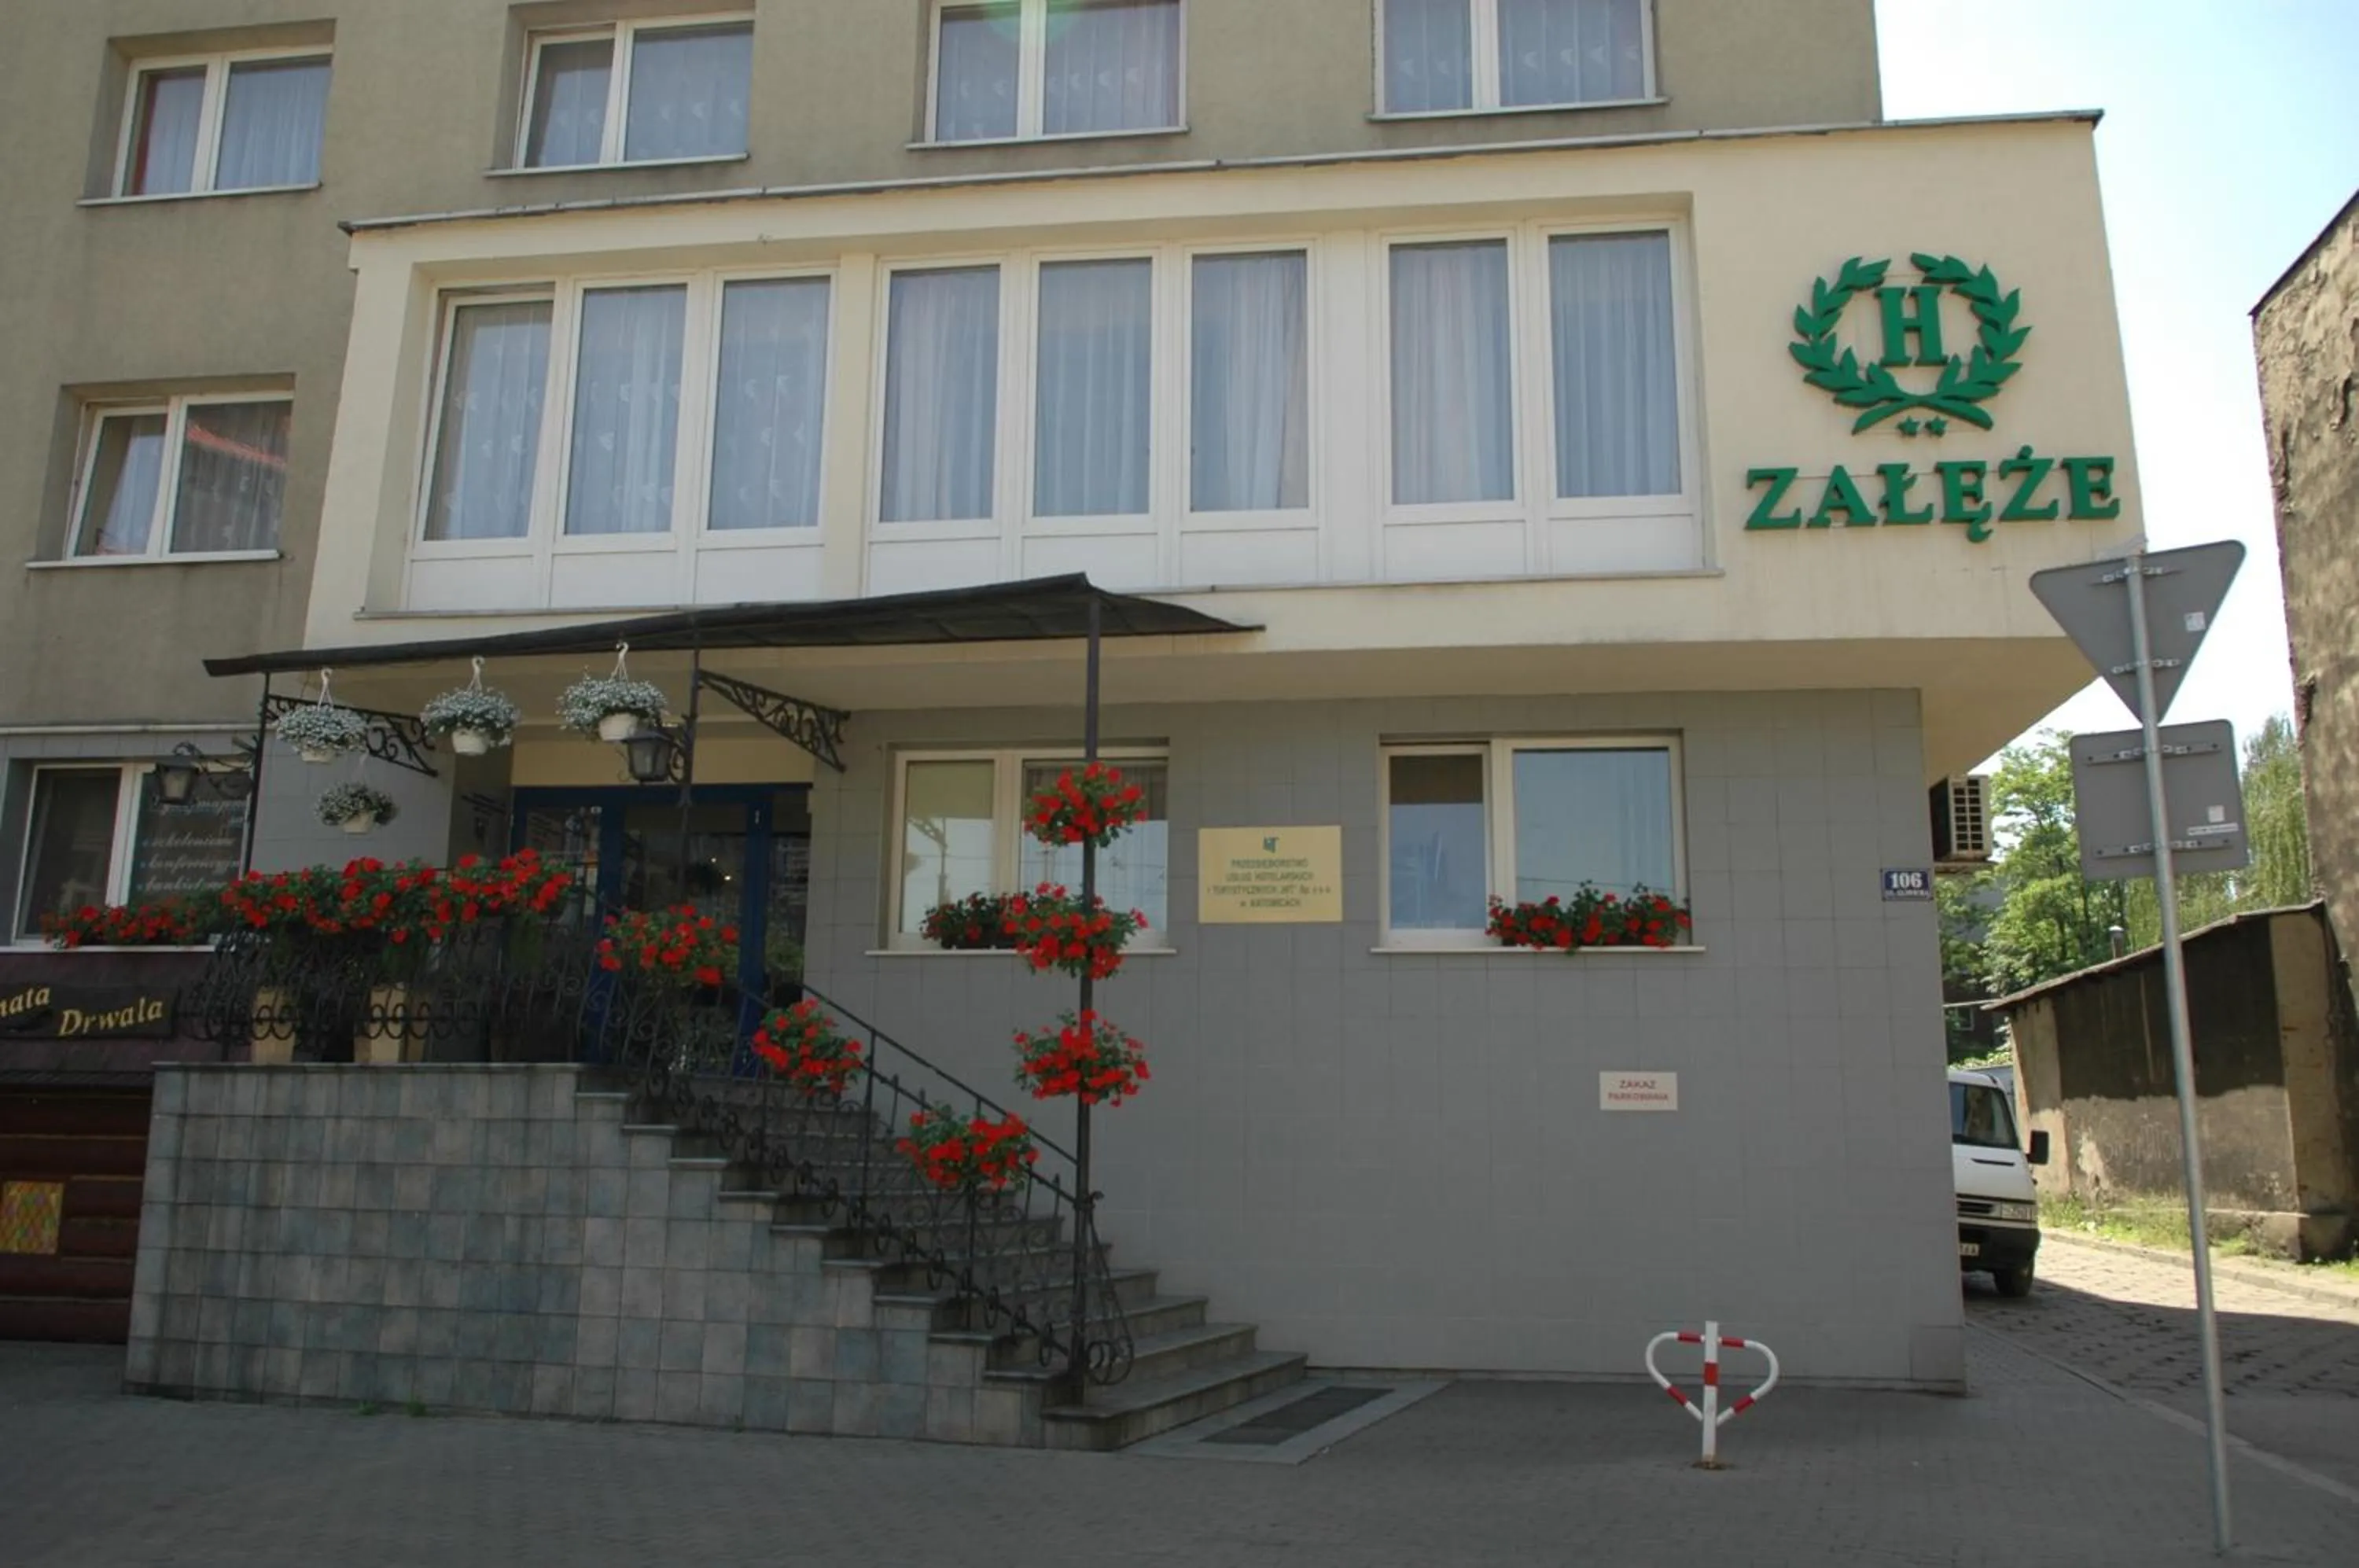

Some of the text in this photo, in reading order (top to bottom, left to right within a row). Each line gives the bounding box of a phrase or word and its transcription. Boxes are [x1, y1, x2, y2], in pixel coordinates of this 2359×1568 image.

[1875, 286, 1949, 367] H
[1744, 445, 2121, 543] ZAŁĘŻE
[1890, 872, 1923, 888] 106
[58, 997, 164, 1036] Drwala
